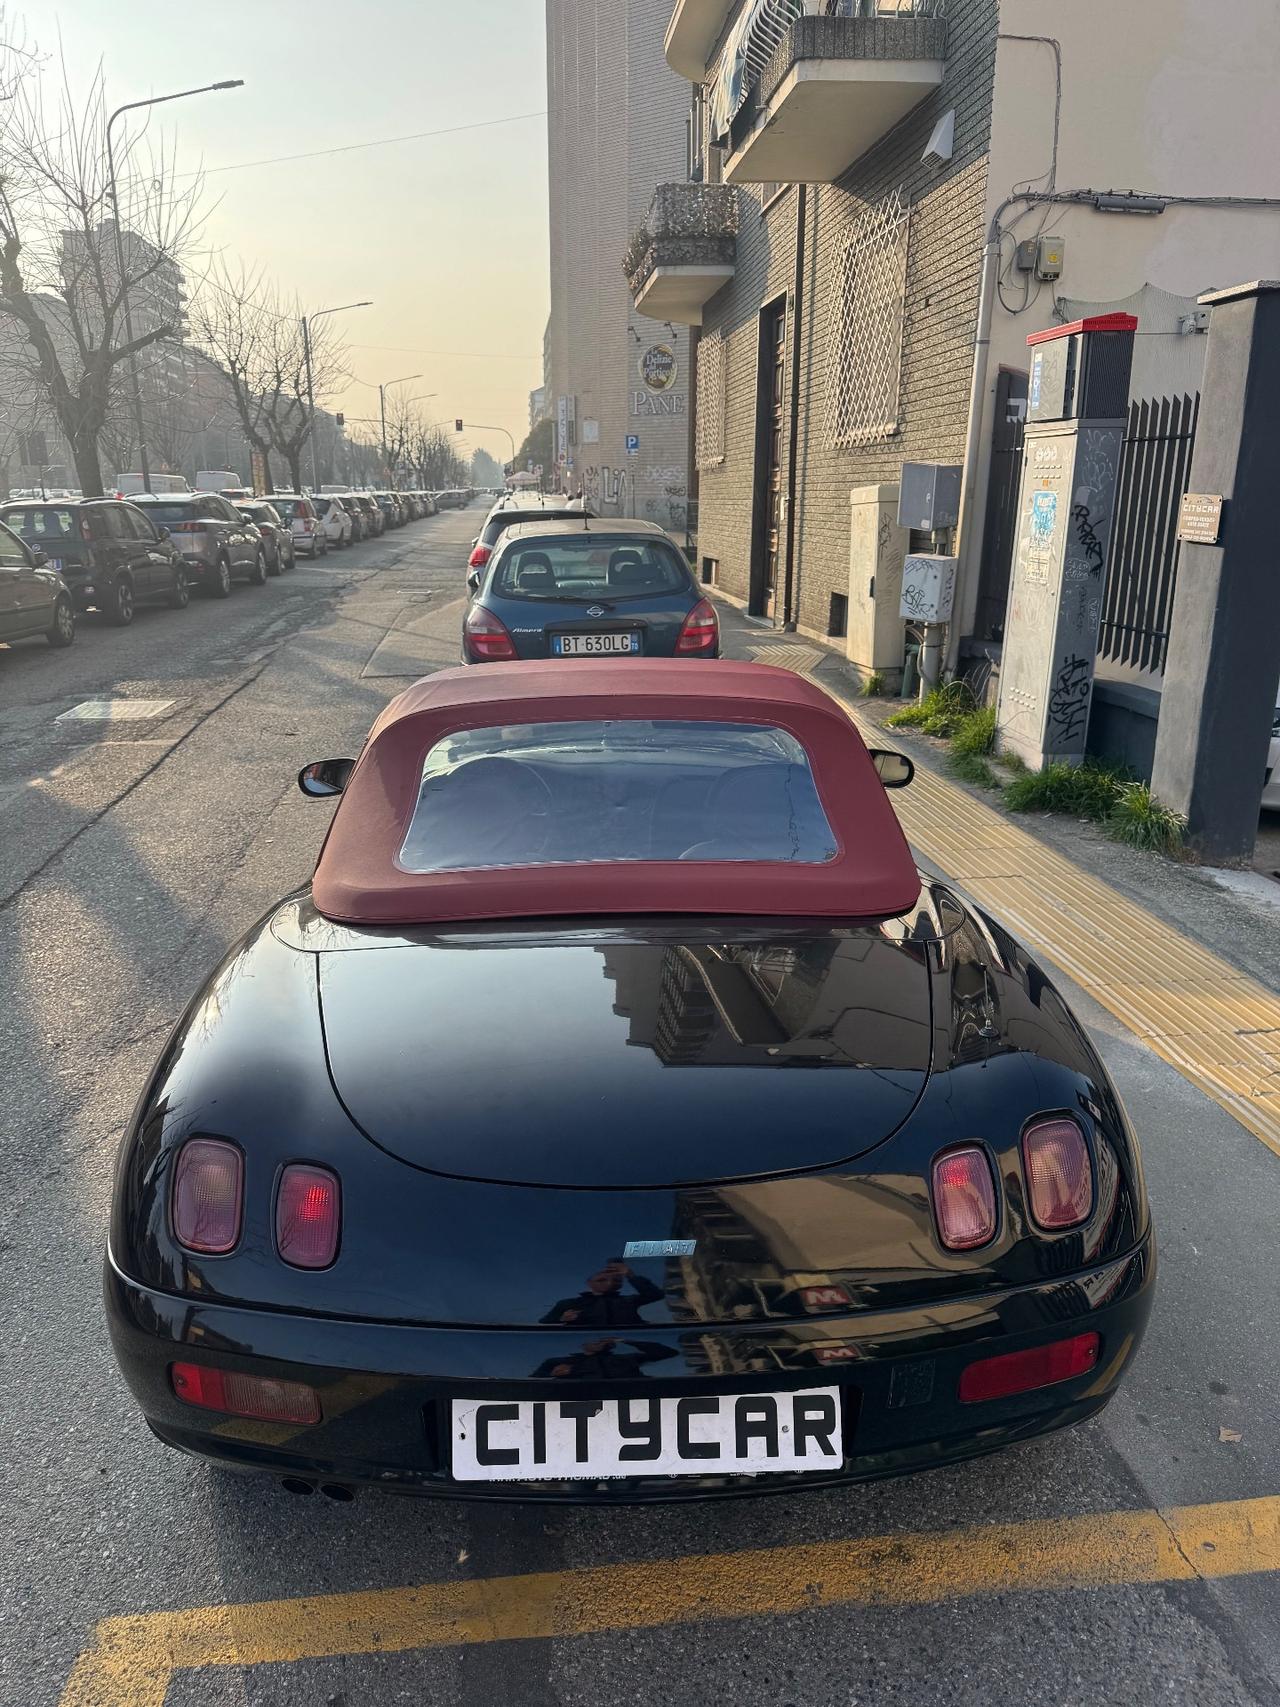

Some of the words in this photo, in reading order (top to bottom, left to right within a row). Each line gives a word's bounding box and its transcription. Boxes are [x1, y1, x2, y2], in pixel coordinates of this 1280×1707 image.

[644, 367, 671, 378] Portico
[631, 391, 684, 415] PANE
[627, 436, 637, 449] P
[1183, 504, 1220, 513] CITYCAR
[563, 637, 580, 652] BT
[585, 635, 629, 651] 630LG
[475, 1394, 838, 1466] CITYCAR
